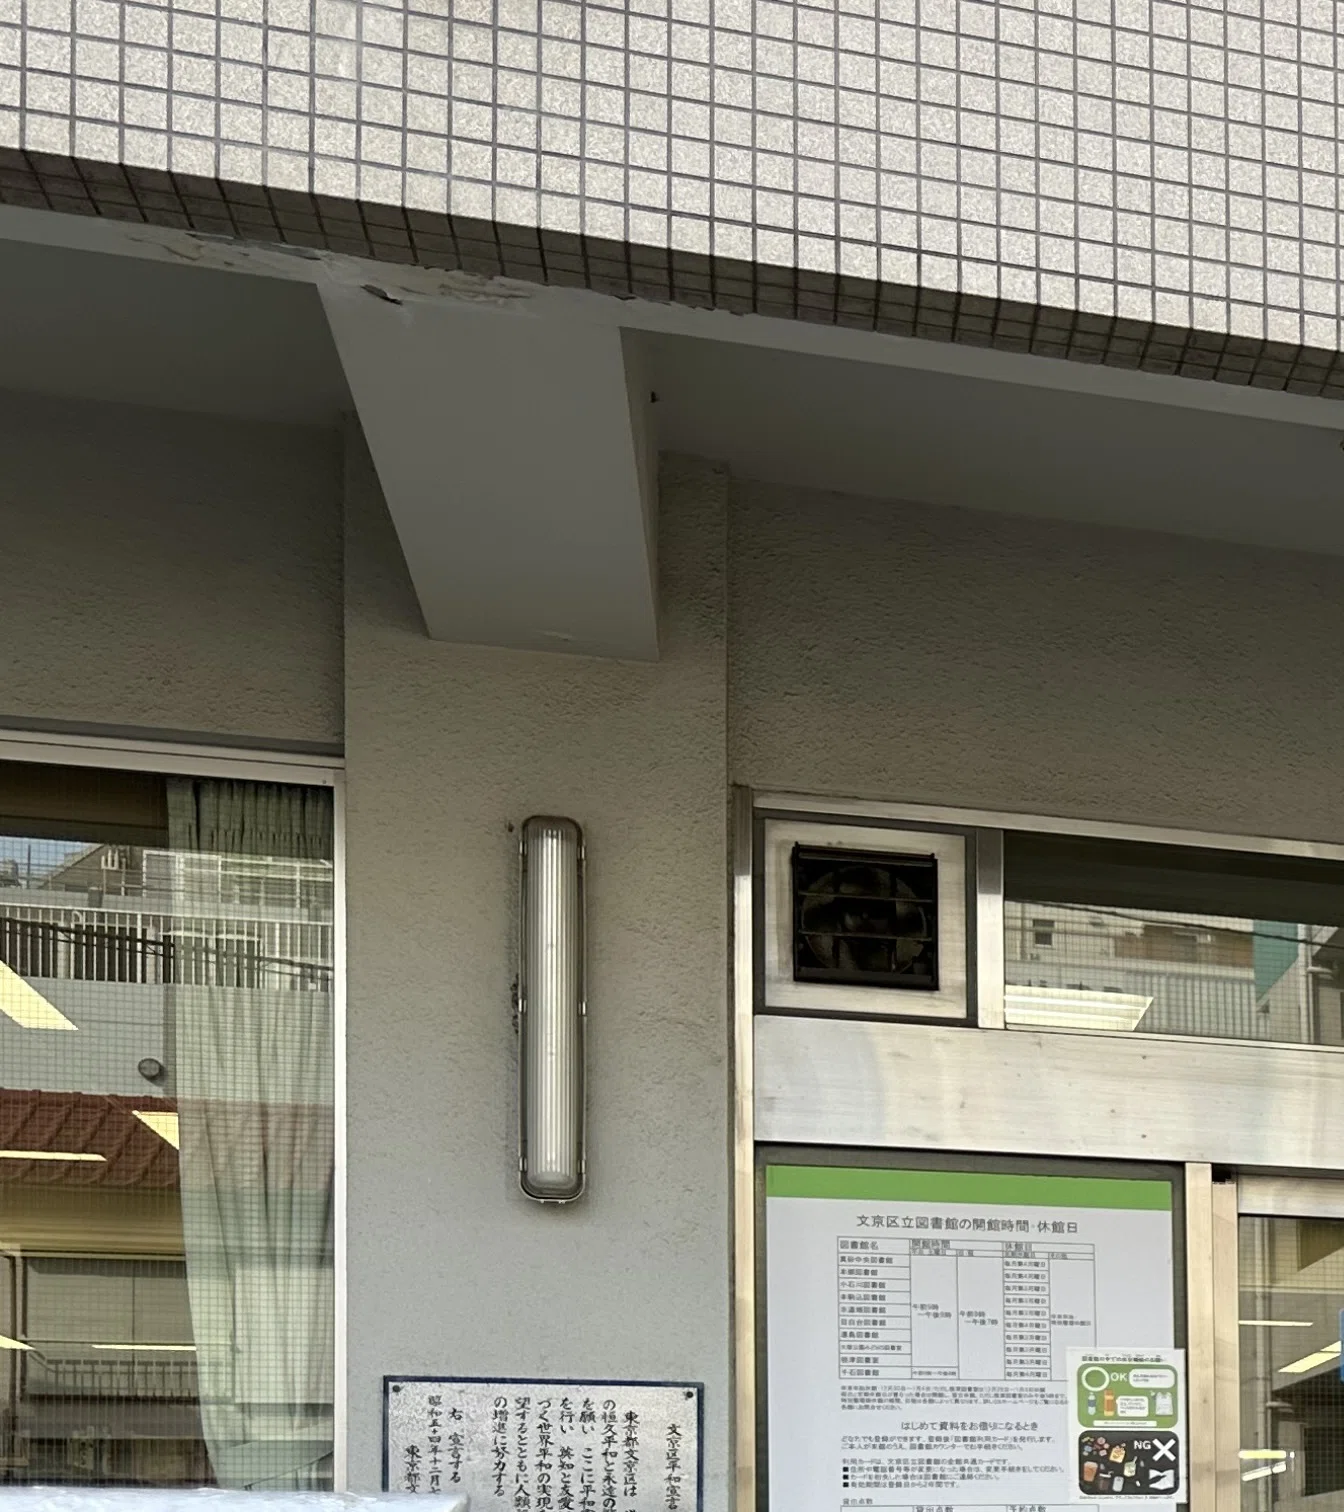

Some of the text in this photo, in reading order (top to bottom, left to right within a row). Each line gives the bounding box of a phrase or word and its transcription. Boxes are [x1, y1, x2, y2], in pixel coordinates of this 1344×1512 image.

[856, 1214, 1078, 1233] 文京区立図書館の開館時間・休館日
[1110, 1372, 1127, 1382] OK
[560, 1397, 575, 1434] を行い
[579, 1397, 596, 1434] を願い
[447, 1407, 464, 1483] 右 宣言する
[491, 1396, 510, 1497] の増進に努力する
[622, 1410, 641, 1498] 東京都文京区は
[1134, 1440, 1151, 1450] NG
[664, 1423, 683, 1510] 文京区平和宣言
